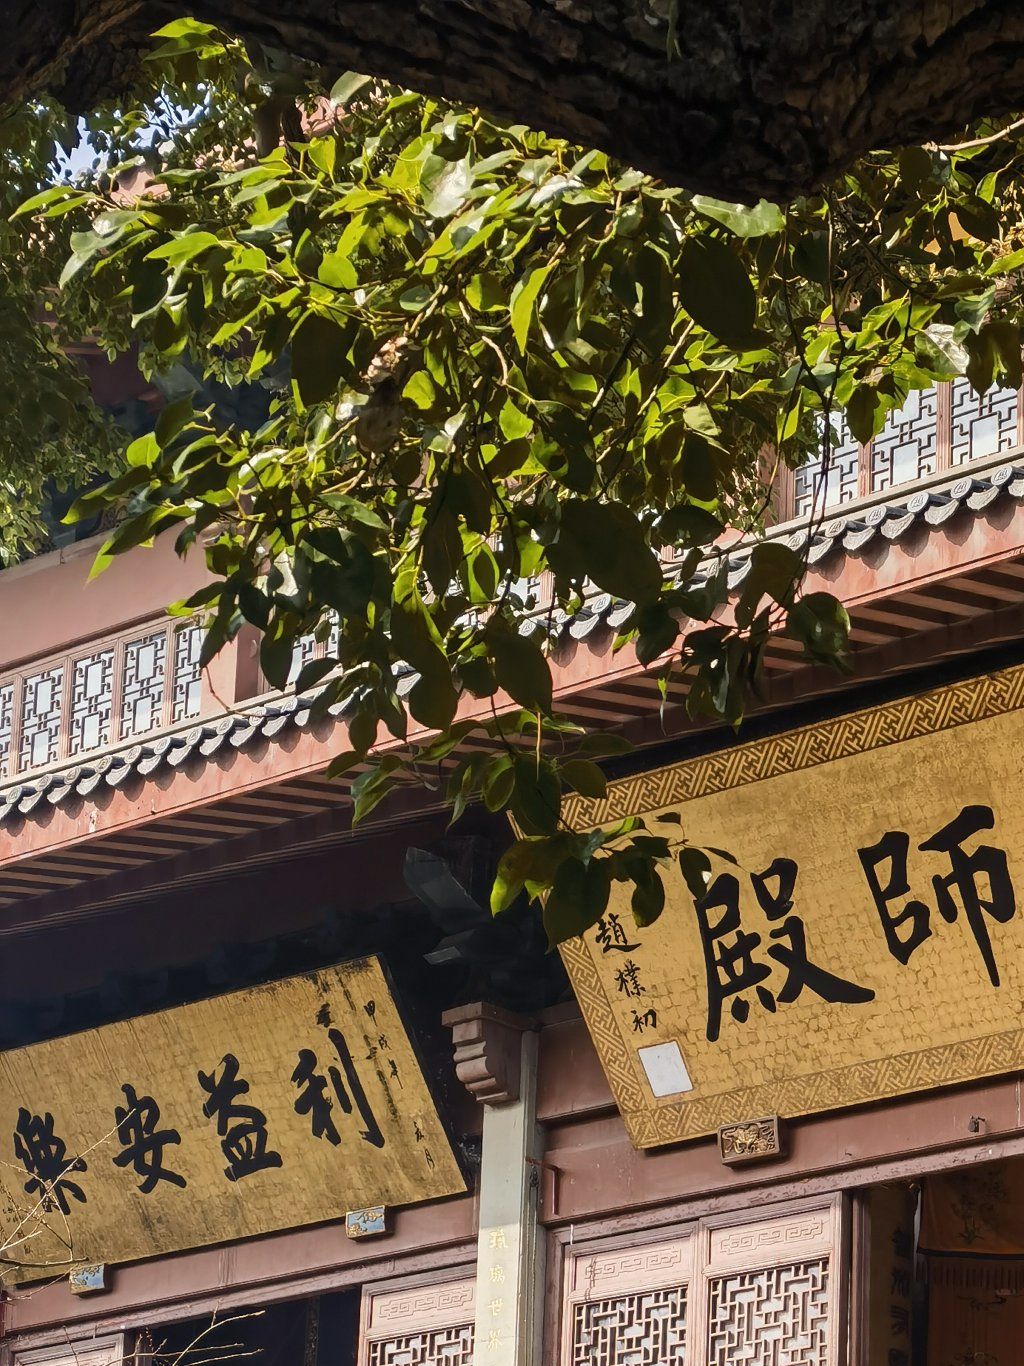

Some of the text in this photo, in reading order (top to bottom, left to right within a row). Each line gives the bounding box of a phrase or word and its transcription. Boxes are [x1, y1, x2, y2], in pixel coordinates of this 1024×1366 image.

[595, 912, 657, 1034] 趙樸初
[13, 1028, 385, 1215] 利益安樂
